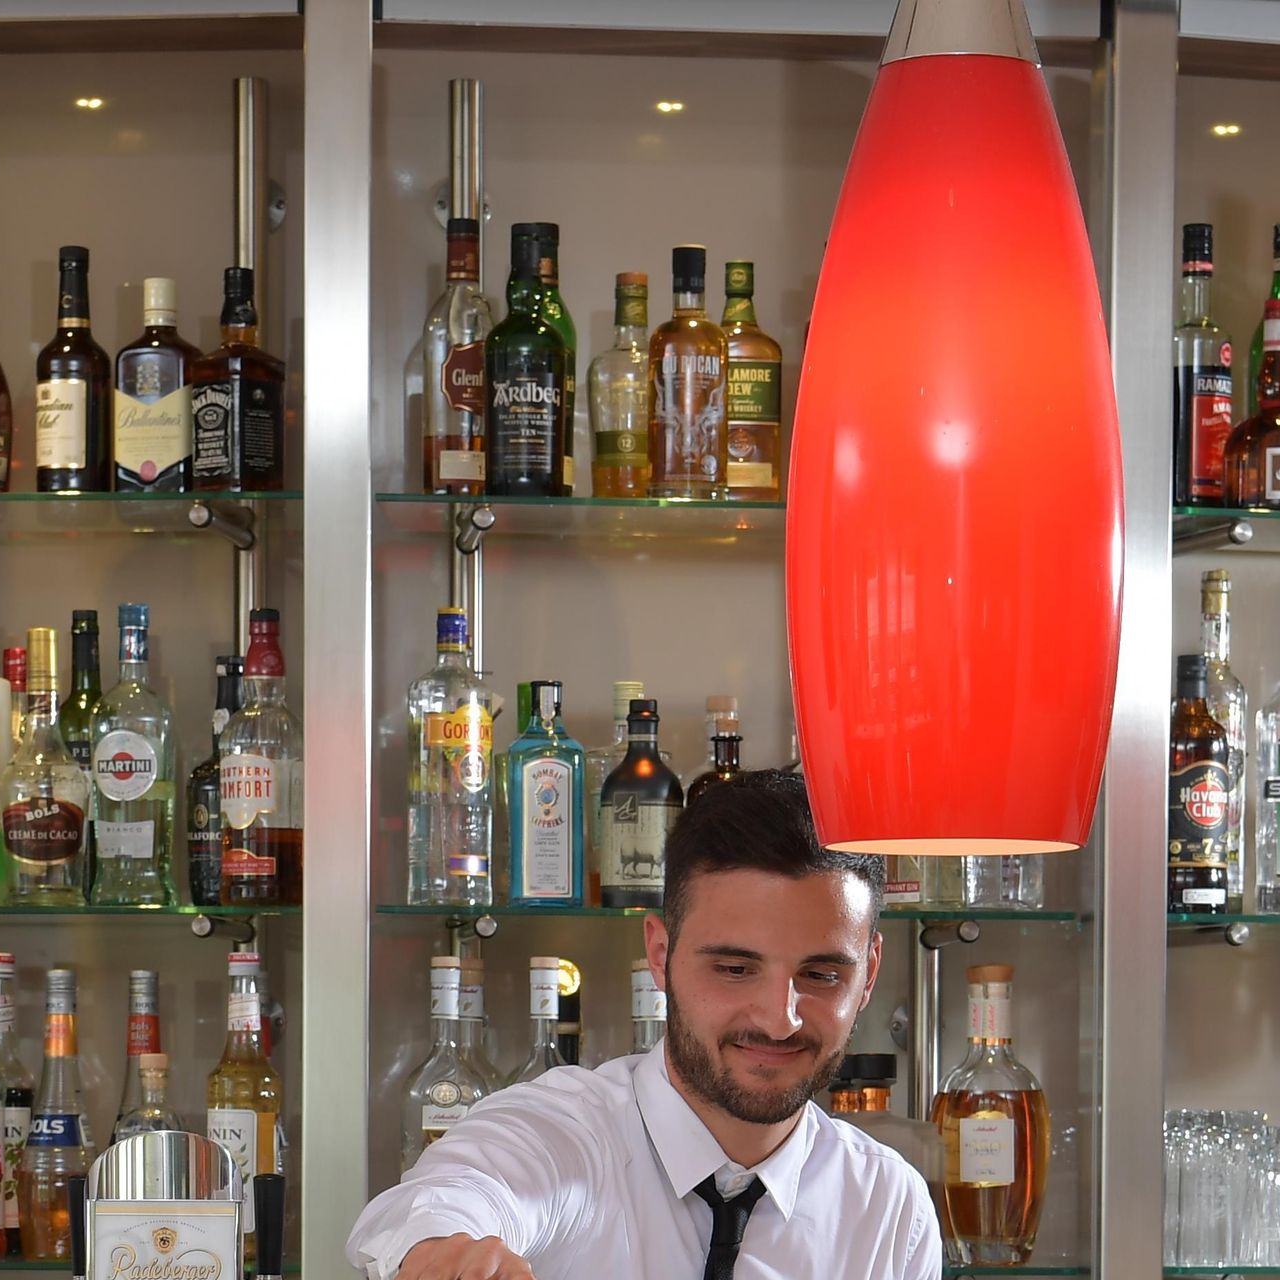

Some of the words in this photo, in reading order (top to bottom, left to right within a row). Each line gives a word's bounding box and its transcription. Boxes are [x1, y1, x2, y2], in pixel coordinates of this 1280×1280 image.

[452, 368, 484, 387] Glenf
[728, 368, 771, 382] LAMORE
[621, 438, 632, 448] 12
[99, 761, 150, 773] MARTINI
[532, 768, 563, 781] BOMBAY
[1180, 787, 1227, 804] Havana
[24, 804, 60, 821] BOLS
[1192, 803, 1221, 818] Club
[531, 815, 565, 828] SAPPHIRE
[49, 830, 78, 841] CACAO
[1202, 838, 1214, 855] 7
